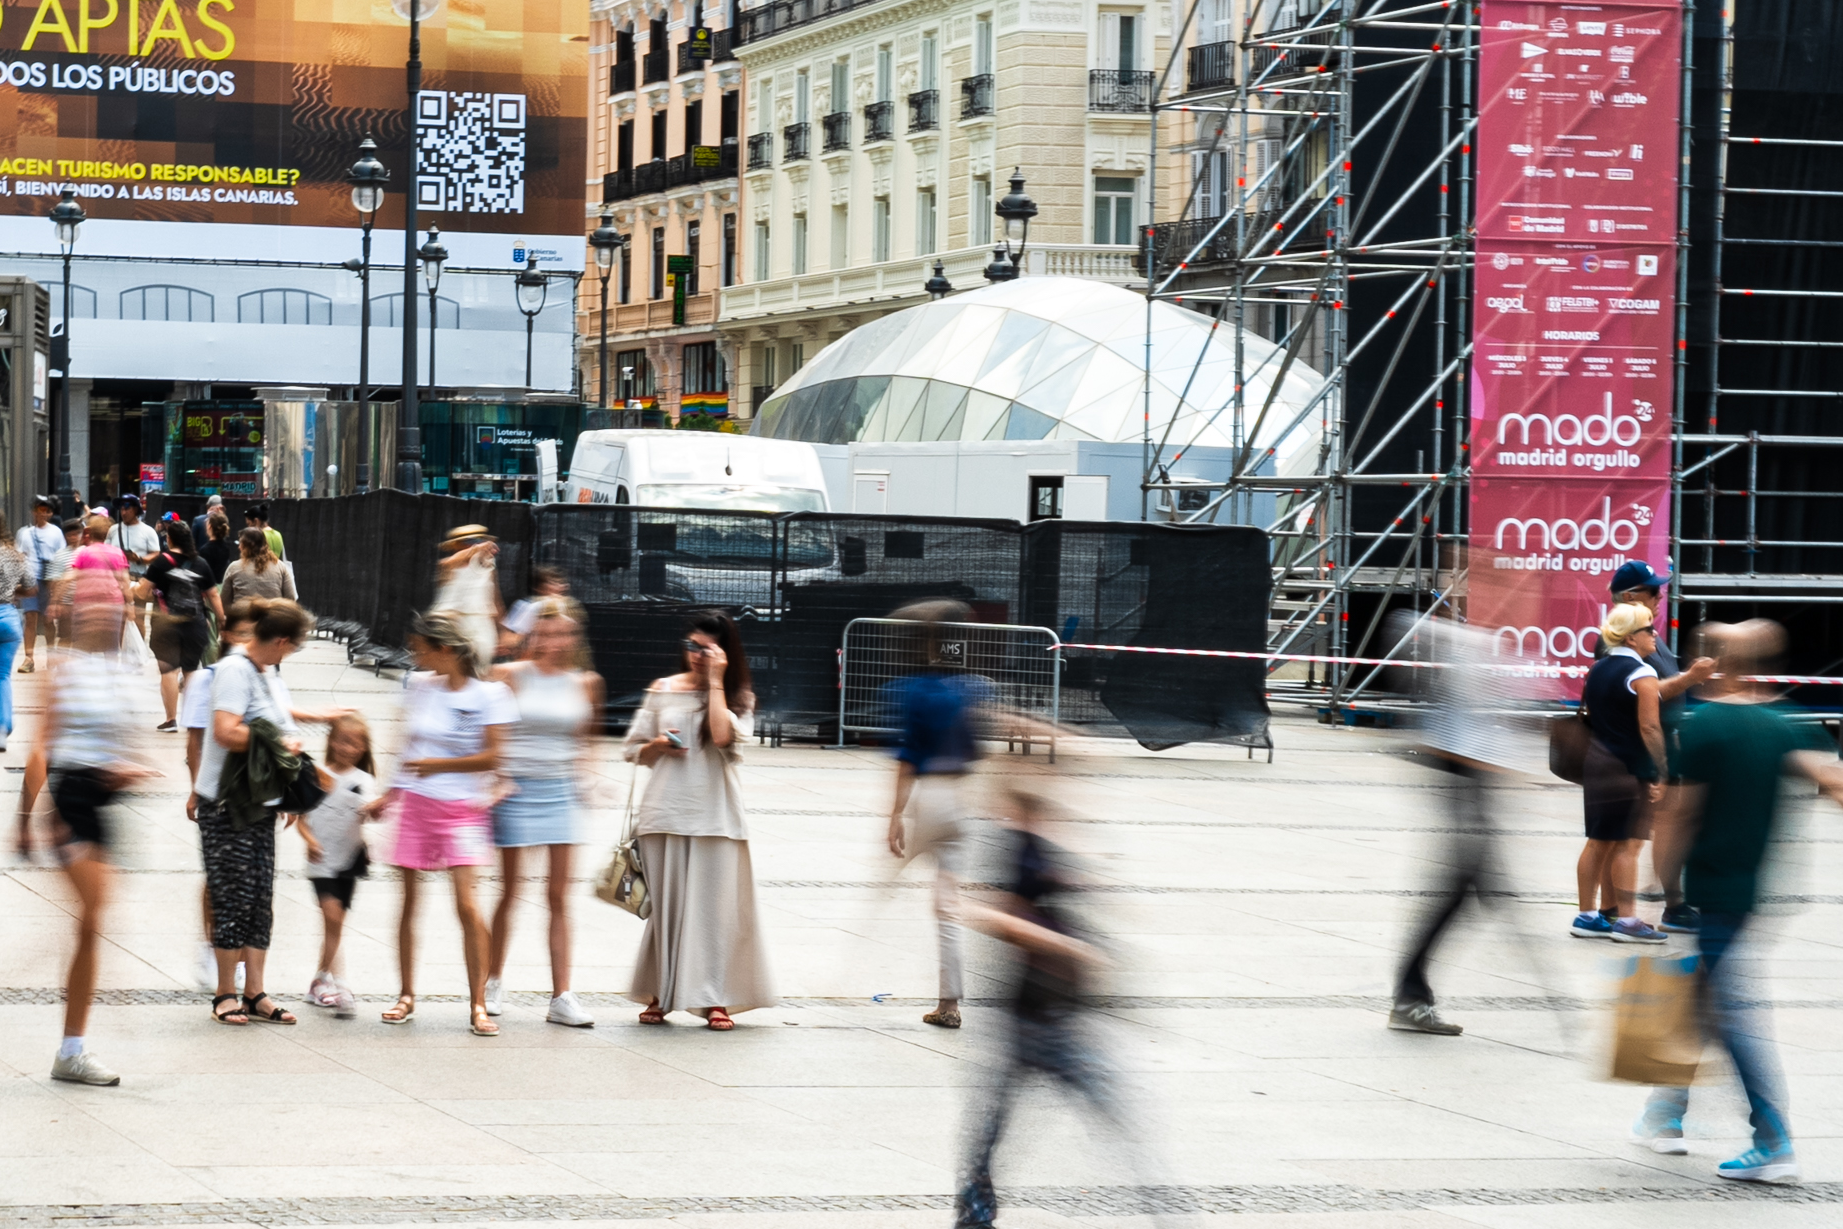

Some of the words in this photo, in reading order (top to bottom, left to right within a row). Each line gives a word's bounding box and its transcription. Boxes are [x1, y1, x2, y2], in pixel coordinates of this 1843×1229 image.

[52, 64, 104, 92] LOS
[108, 61, 235, 96] PÚBLICOS
[57, 159, 146, 180] TURISMO
[150, 163, 300, 186] RESPONSABLE?
[116, 185, 130, 199] A
[133, 186, 163, 201] LAS
[166, 187, 211, 203] ISLAS
[213, 188, 299, 206] CANARIAS.
[1619, 299, 1660, 310] COGAM
[1543, 330, 1600, 341] HORARIOS
[187, 416, 201, 427] BIG
[1497, 391, 1642, 447] mado
[497, 437, 531, 445] Apuestas
[1497, 448, 1567, 466] madrid
[1573, 449, 1641, 471] orgullo
[222, 481, 256, 492] MADRID
[1495, 496, 1639, 551] mado
[1493, 553, 1563, 571] madrid
[1569, 553, 1634, 575] orgull
[1492, 604, 1607, 658] mad
[940, 643, 960, 654] AMS
